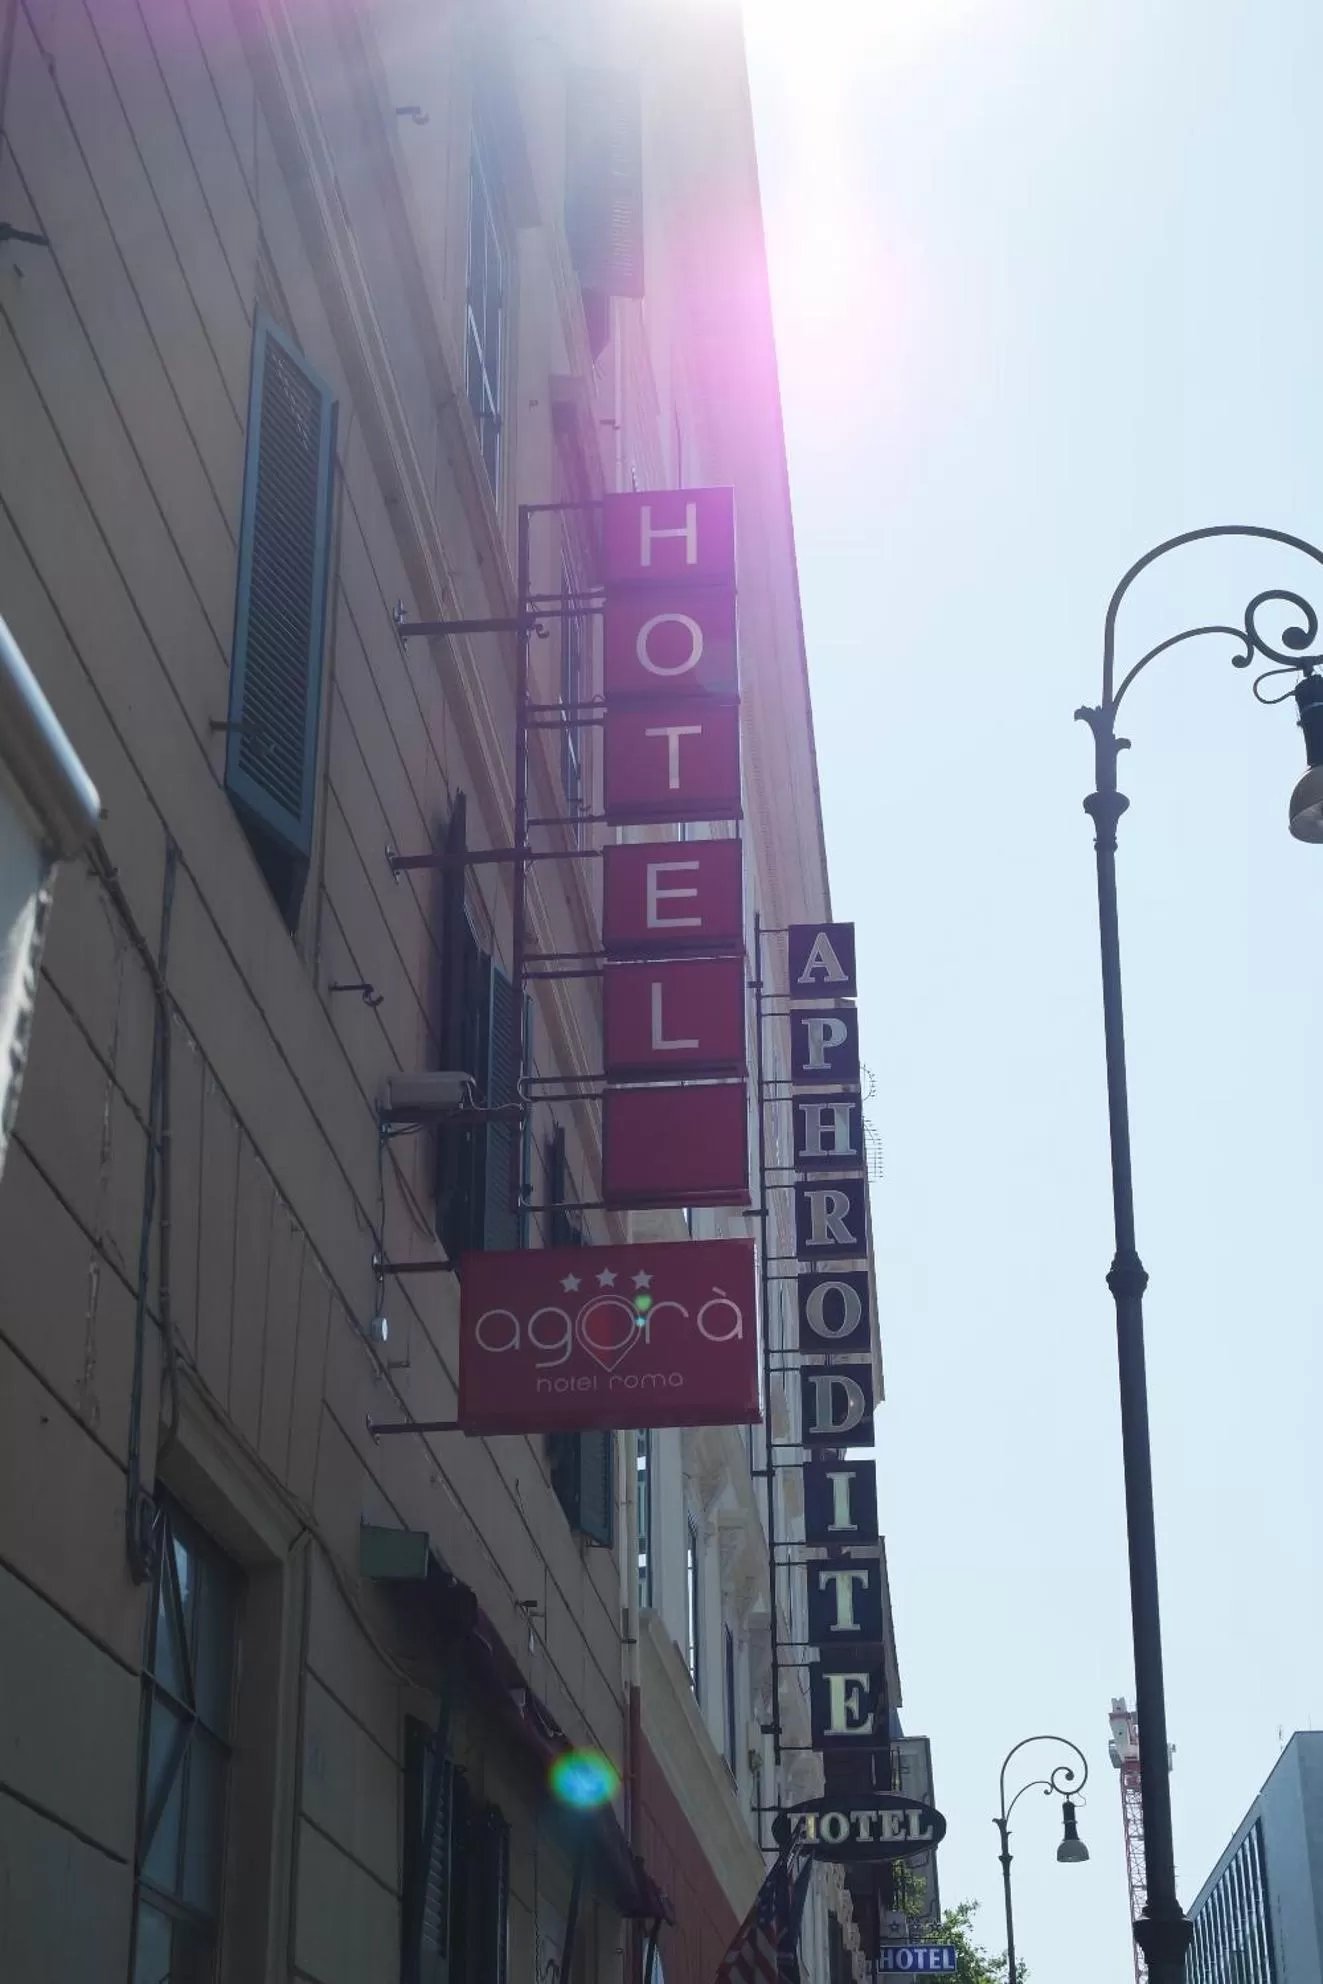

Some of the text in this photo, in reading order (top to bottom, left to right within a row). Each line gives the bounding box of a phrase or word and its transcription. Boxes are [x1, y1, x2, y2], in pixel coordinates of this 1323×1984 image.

[636, 502, 704, 1051] HOTEL
[475, 1287, 743, 1368] agorà
[797, 931, 875, 1737] APHRODITE
[536, 1372, 684, 1393] hotel roma
[787, 1809, 933, 1844] HOTEL
[880, 1949, 955, 1970] HOTEL
